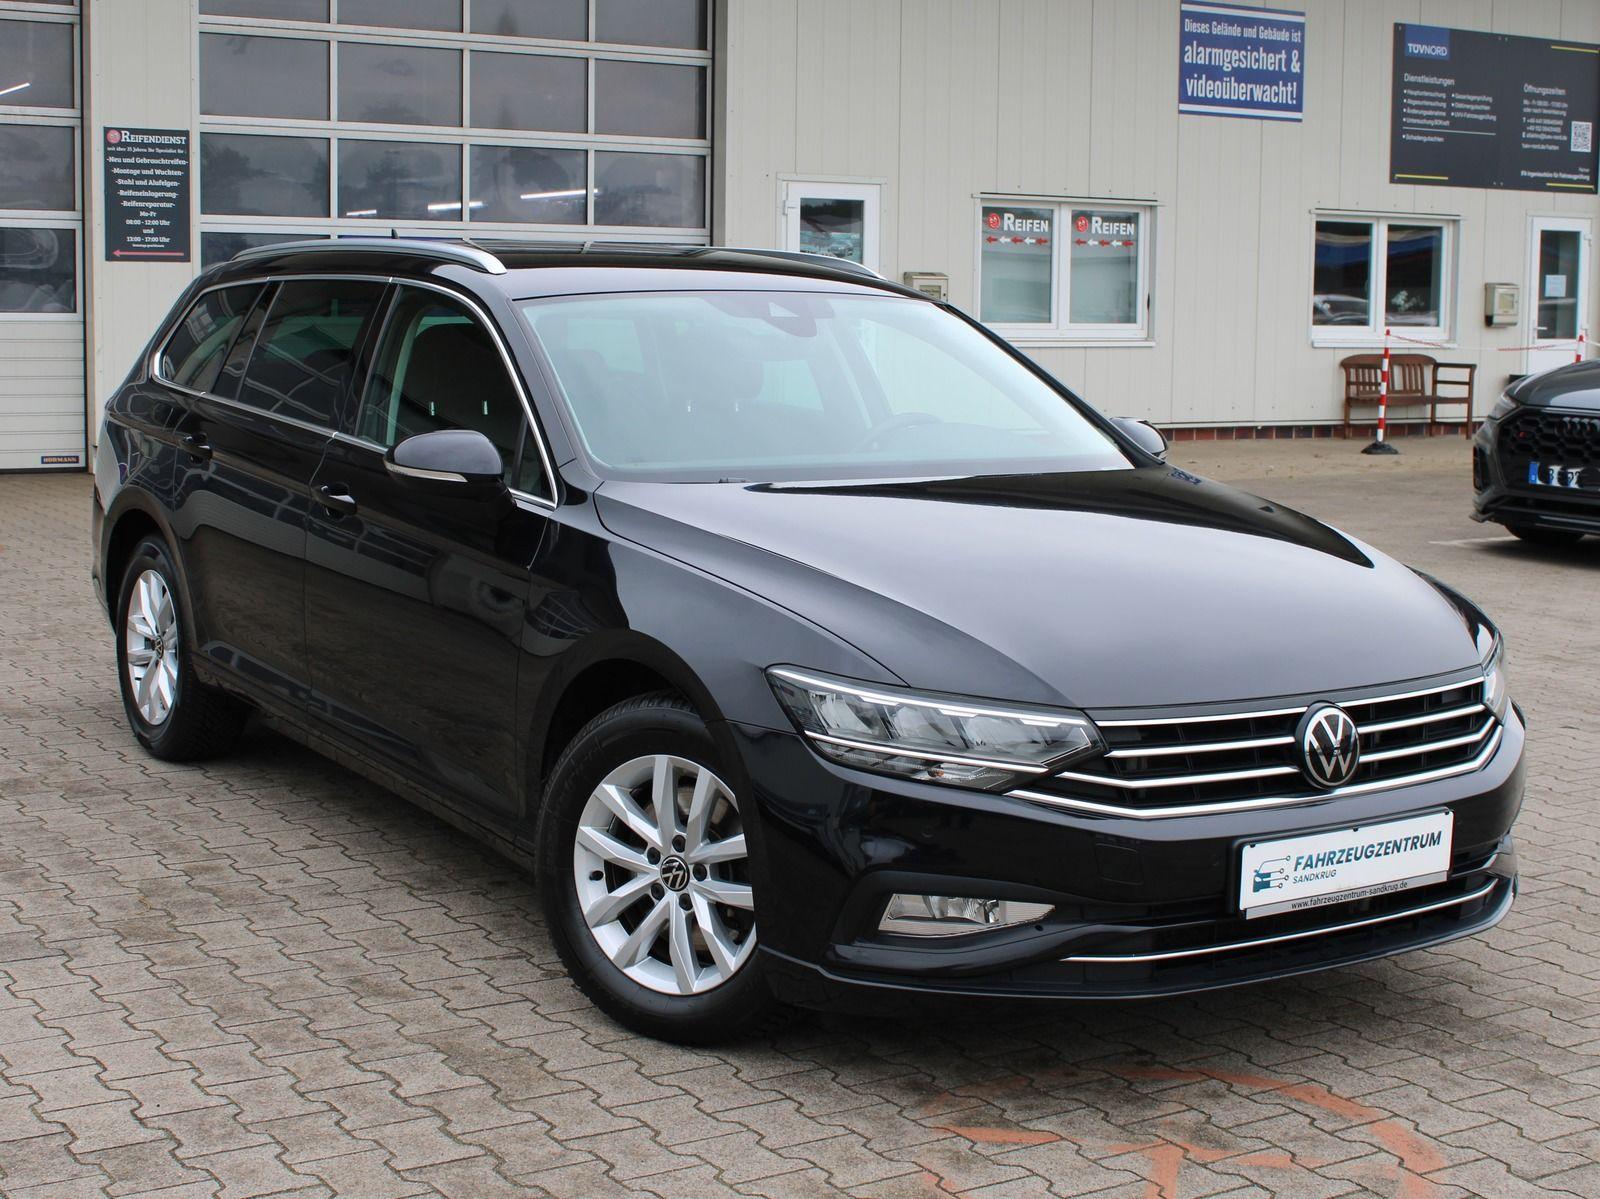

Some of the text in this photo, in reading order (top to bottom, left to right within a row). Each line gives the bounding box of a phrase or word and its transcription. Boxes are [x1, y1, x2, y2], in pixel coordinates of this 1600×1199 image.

[1184, 18, 1301, 43] Dieses Gelände und Gebäude ist
[1184, 40, 1301, 73] alarmgesichert &
[1186, 73, 1297, 105] videoüberwacht!
[1403, 73, 1455, 87] Dienstleistungen
[1294, 830, 1442, 872] FAHRZEUGZENTRUM
[1292, 869, 1337, 885] SANDKRUG
[1291, 880, 1409, 910] www.fahrzeugzentrum-sandkrug.de
